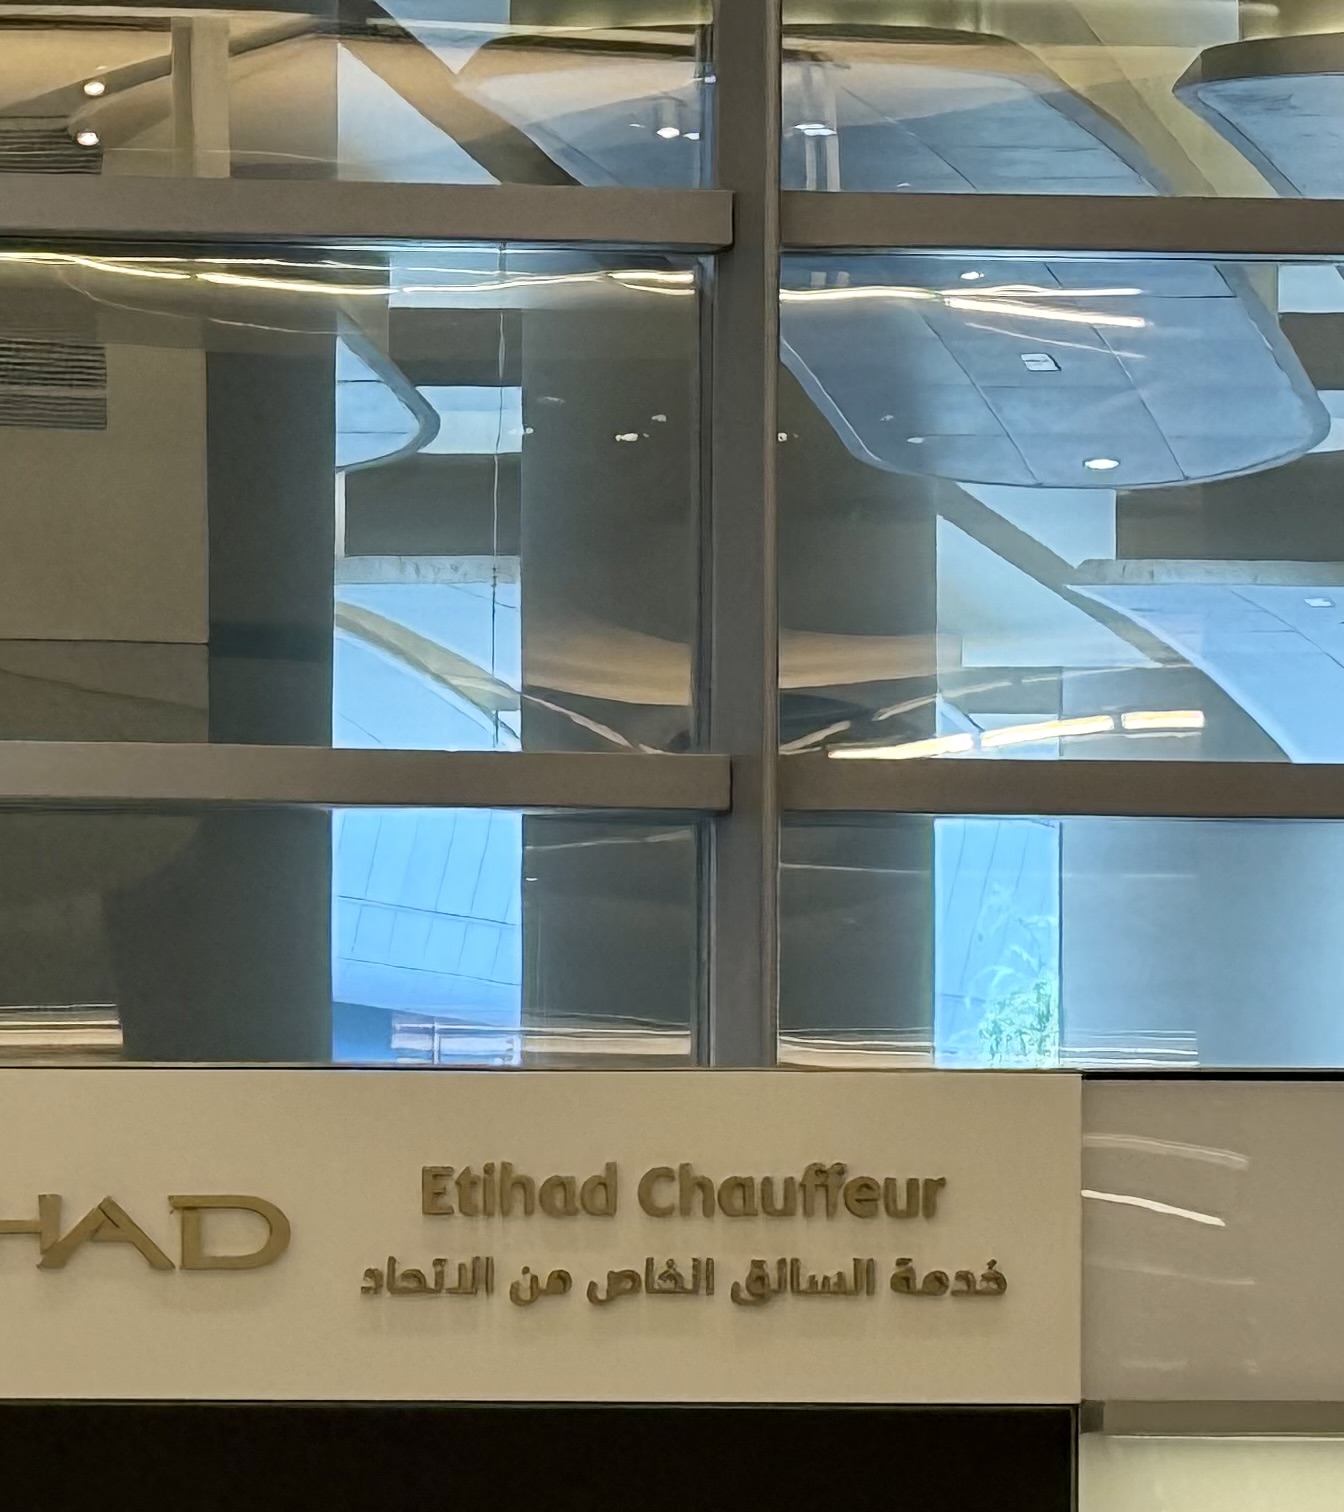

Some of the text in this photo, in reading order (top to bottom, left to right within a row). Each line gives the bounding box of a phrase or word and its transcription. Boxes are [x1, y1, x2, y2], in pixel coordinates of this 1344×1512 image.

[420, 1161, 948, 1220] Etihad Chauffeur
[509, 1264, 574, 1307] من
[585, 1256, 716, 1305] الخاص
[889, 1256, 1009, 1299] خدمة
